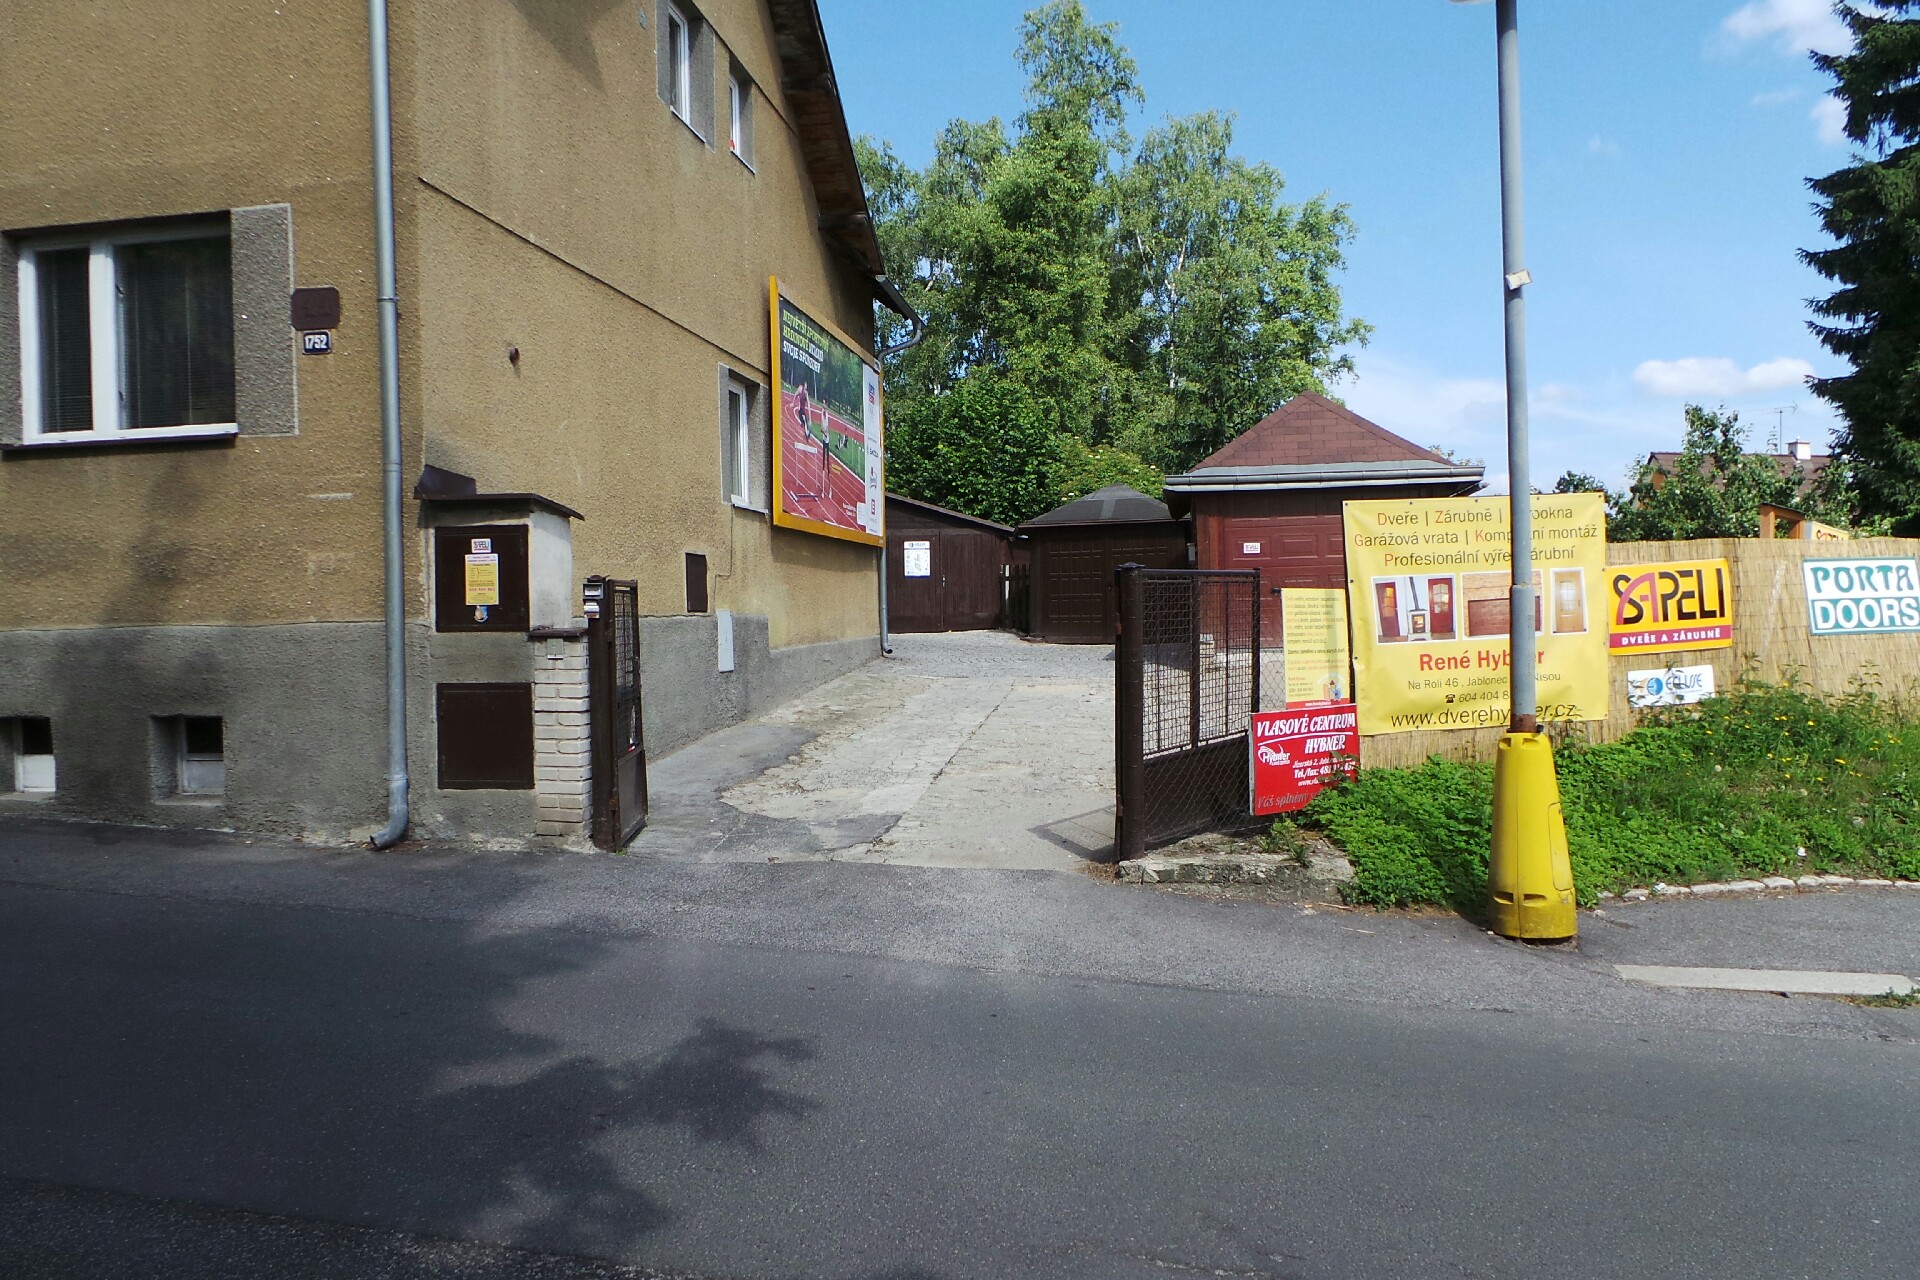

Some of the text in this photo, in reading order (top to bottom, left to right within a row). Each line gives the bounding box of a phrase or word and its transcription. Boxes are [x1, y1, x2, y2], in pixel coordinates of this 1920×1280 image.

[305, 335, 327, 349] 1752
[1377, 511, 1419, 526] Dveře
[1434, 508, 1492, 524] Zárubně
[1354, 531, 1419, 547] Garážová
[1423, 532, 1459, 544] vrata
[1548, 524, 1598, 539] montáž
[1384, 549, 1480, 567] Profesionální
[1530, 546, 1575, 561] árubní
[1810, 565, 1914, 594] PORTA
[1613, 568, 1726, 626] SAPELI
[1813, 597, 1920, 629] DOORS
[1621, 628, 1721, 646] DVEŘE A ZÁRUBNĚ
[1419, 650, 1471, 672] René
[1408, 681, 1421, 690] Na
[1424, 679, 1442, 689] Roli
[1466, 675, 1507, 687] Jablonec
[1458, 693, 1477, 703] 604
[1480, 691, 1499, 701] 404
[1257, 712, 1356, 737] VLASOVÉ CENTRUM
[1304, 735, 1346, 754] HYBNER
[1263, 752, 1291, 765] Hybner
